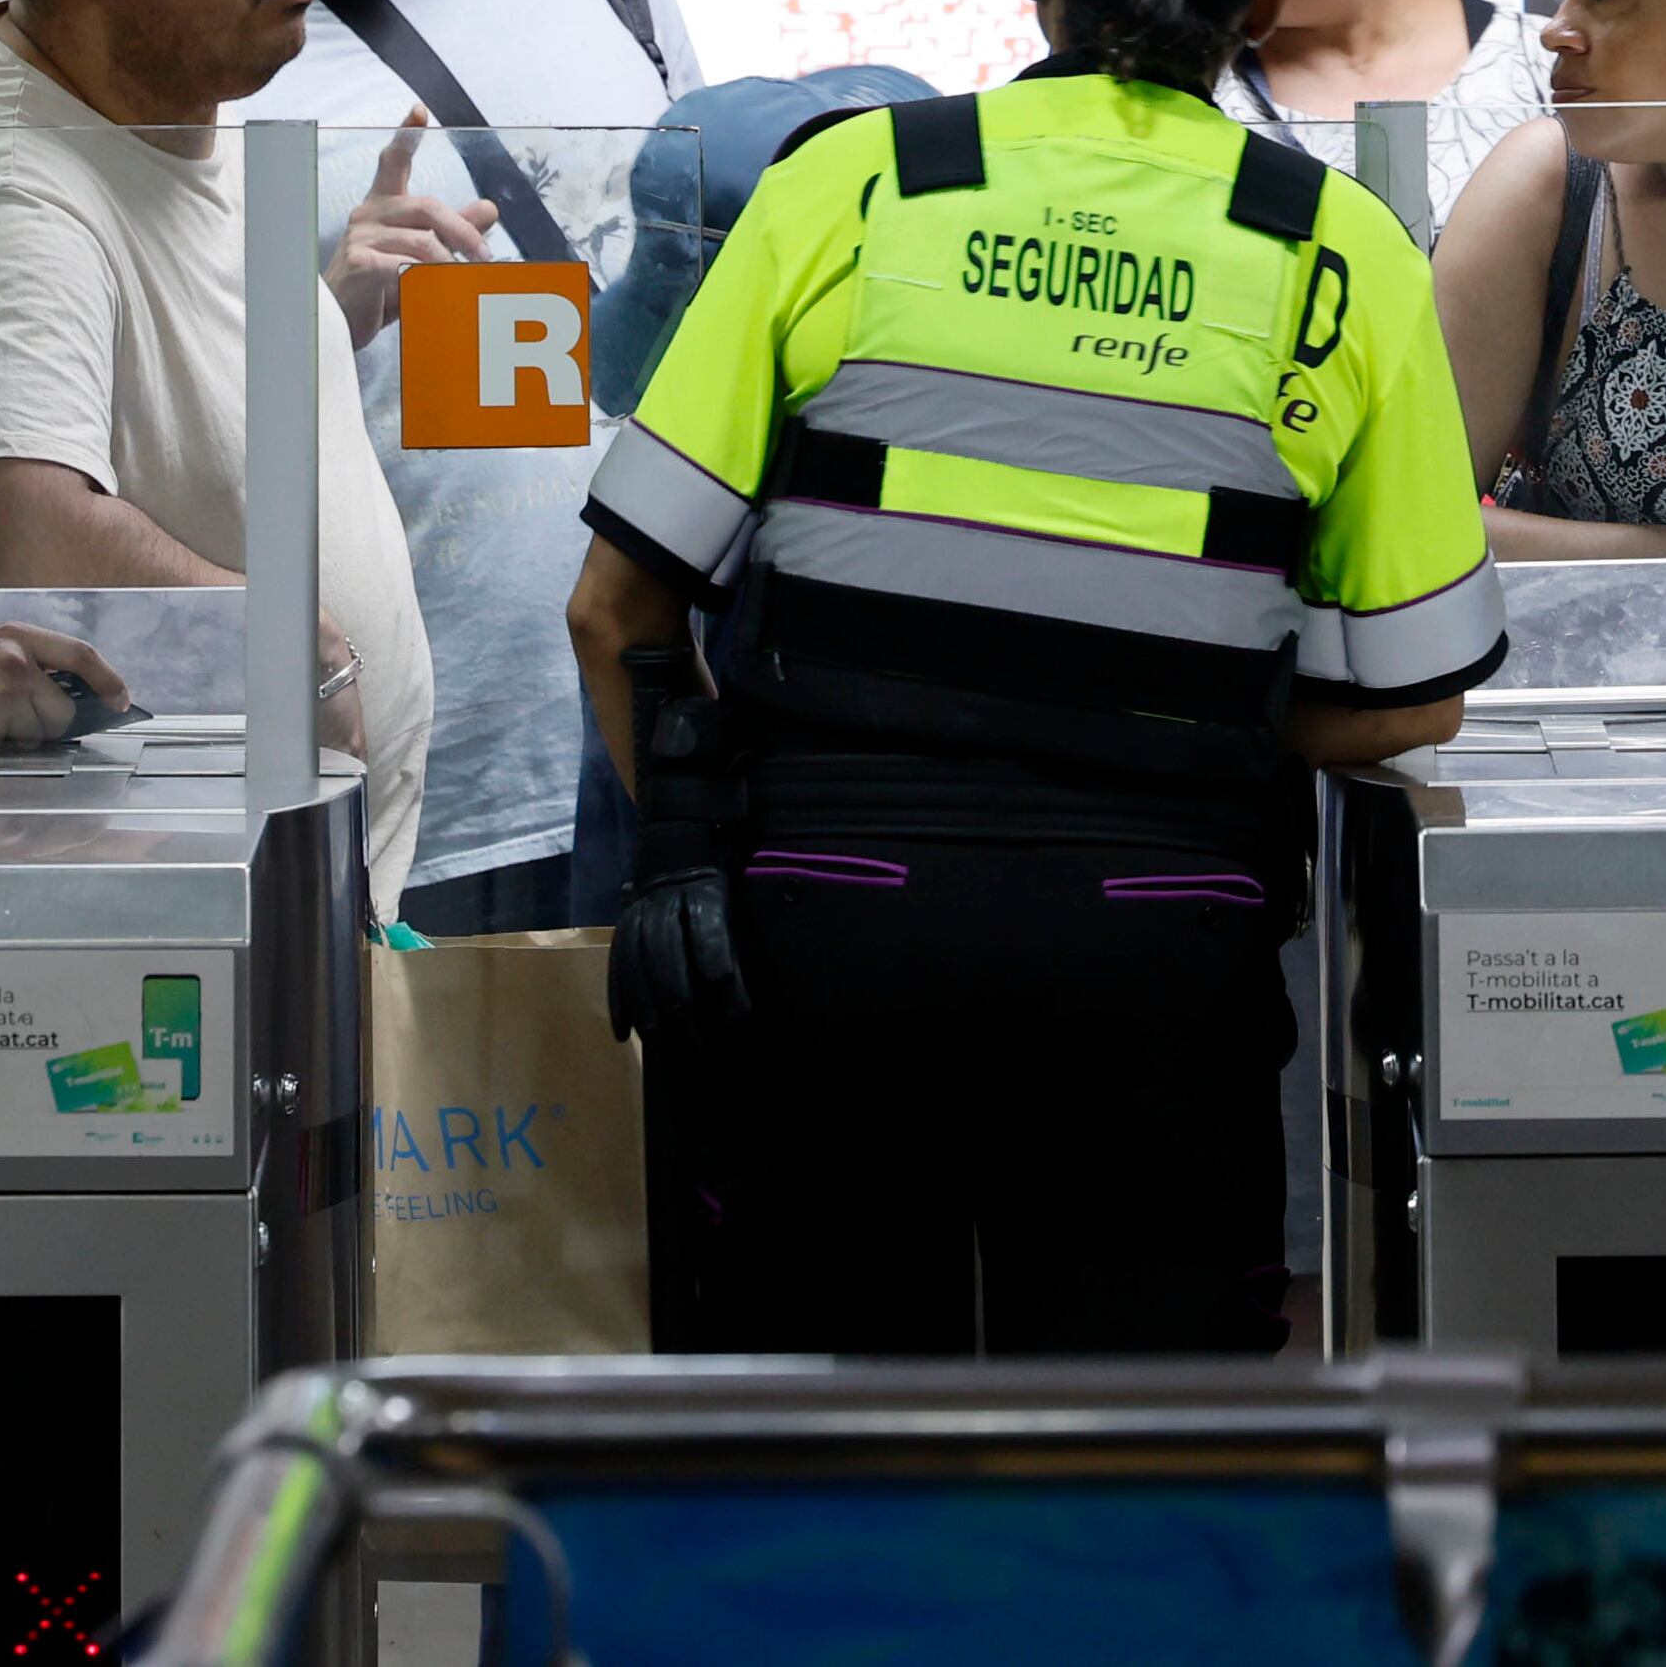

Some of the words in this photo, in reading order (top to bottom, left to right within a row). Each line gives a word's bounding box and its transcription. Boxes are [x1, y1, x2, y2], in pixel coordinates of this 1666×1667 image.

[1072, 211, 1119, 236] SEC
[963, 230, 1195, 322] SEGURIDAD
[478, 293, 585, 407] R
[1071, 333, 1190, 375] renfe
[1467, 949, 1538, 967] Passa't
[1544, 953, 1557, 967] a
[1563, 949, 1580, 967] la
[1467, 971, 1582, 989] T-mobilitat
[1587, 974, 1600, 989] a
[1467, 993, 1625, 1011] T-mobilitat.cat
